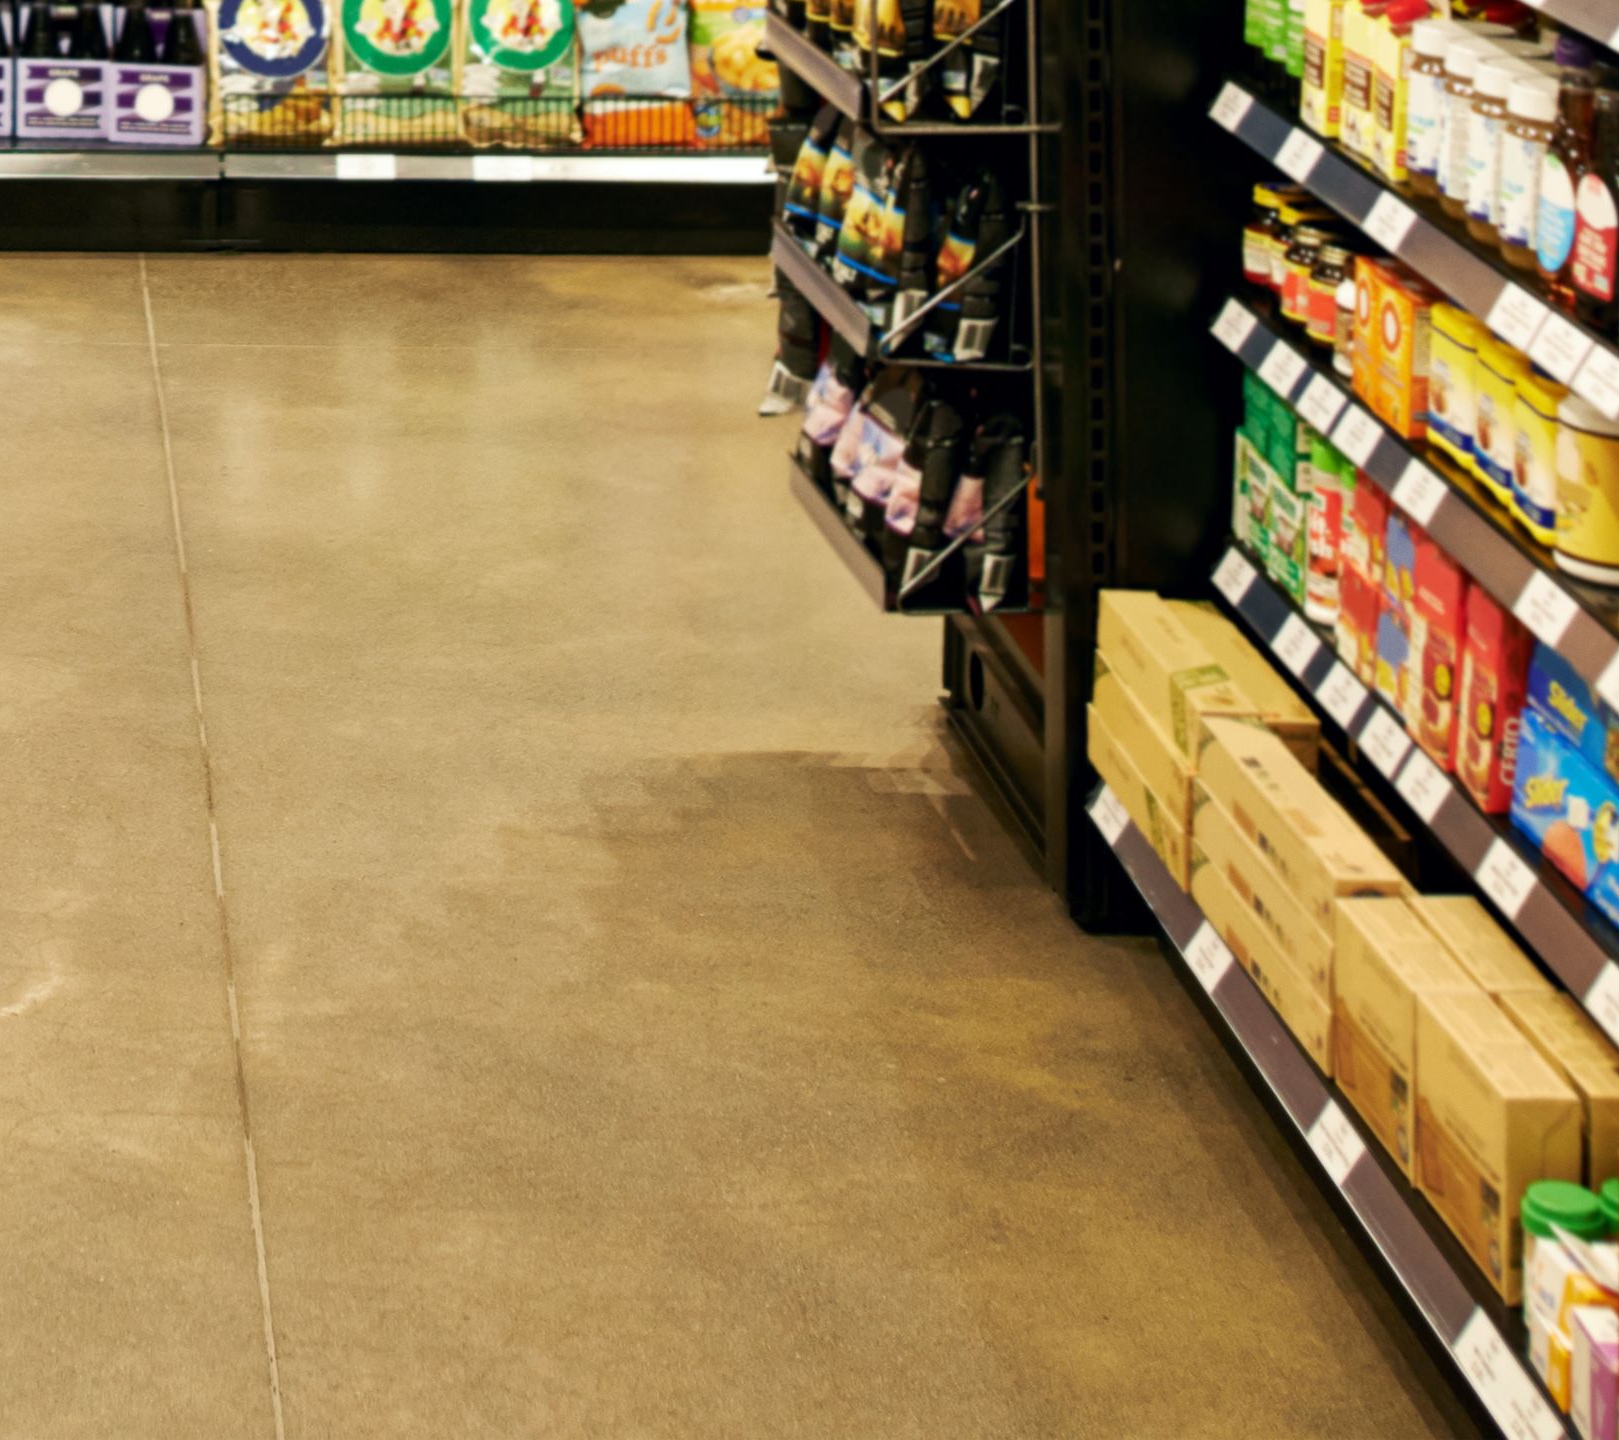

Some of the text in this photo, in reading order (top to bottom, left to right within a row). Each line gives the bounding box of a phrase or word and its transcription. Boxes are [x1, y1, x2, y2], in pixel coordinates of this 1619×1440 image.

[593, 44, 667, 72] puffs
[48, 68, 80, 79] GRAPE
[139, 72, 171, 84] GRAPE
[1548, 679, 1589, 732] Slider
[1499, 716, 1522, 786] CERTO
